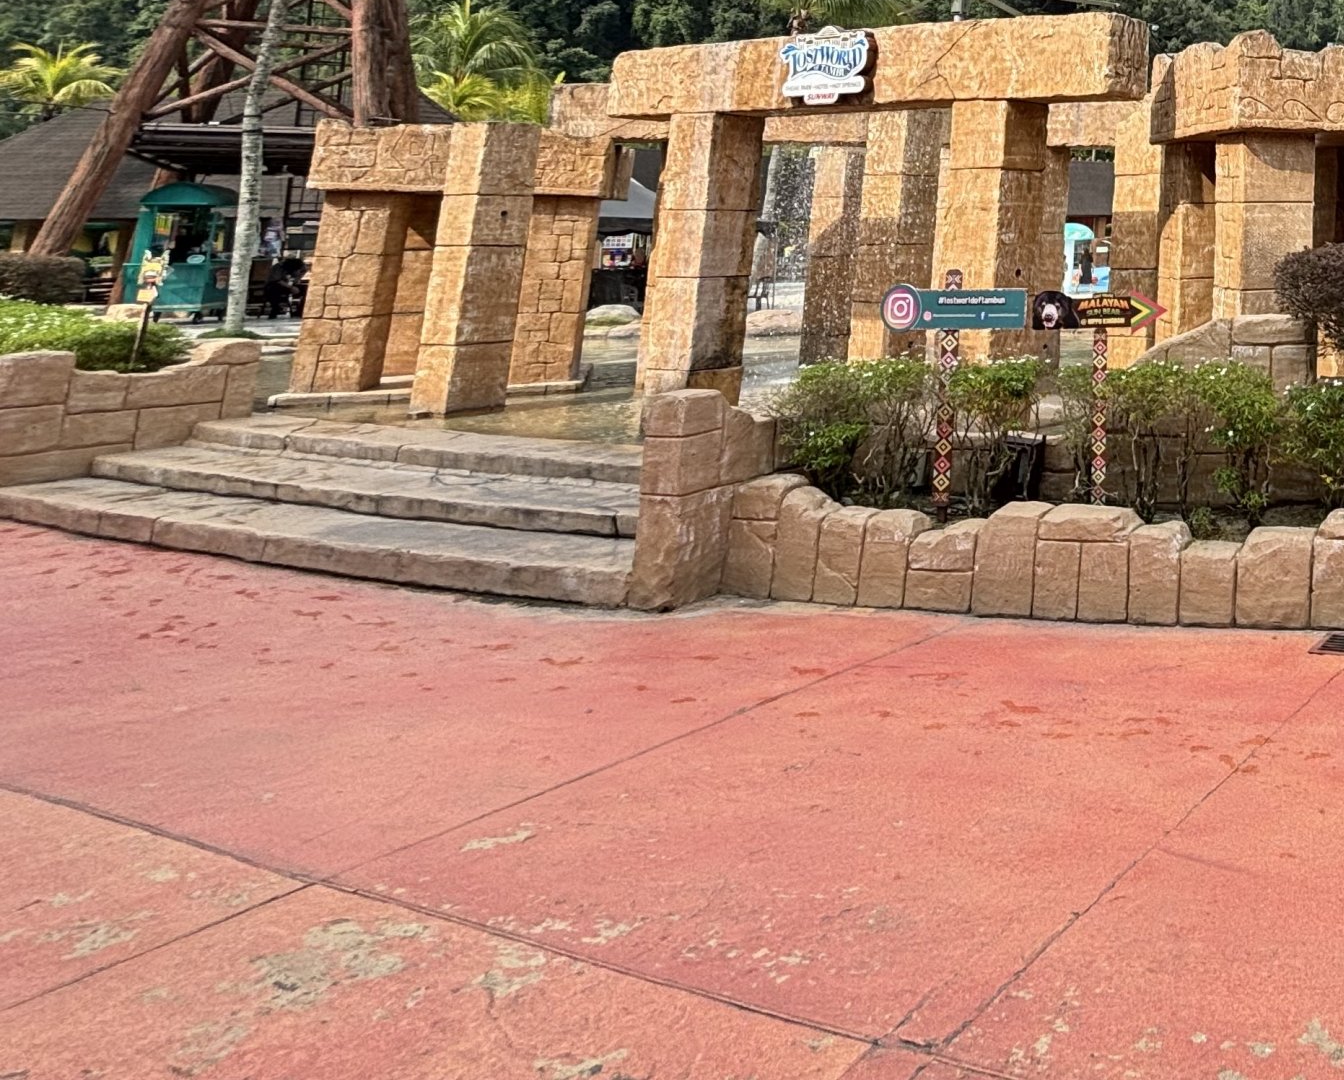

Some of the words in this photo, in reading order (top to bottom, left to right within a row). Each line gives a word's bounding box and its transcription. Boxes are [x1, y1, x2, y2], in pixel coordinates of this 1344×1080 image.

[819, 46, 862, 69] WORLD
[938, 296, 1006, 304] #lostworldoftambun
[1078, 298, 1130, 311] MALAYAN
[1086, 308, 1102, 316] SUN
[1102, 307, 1121, 315] BEAR
